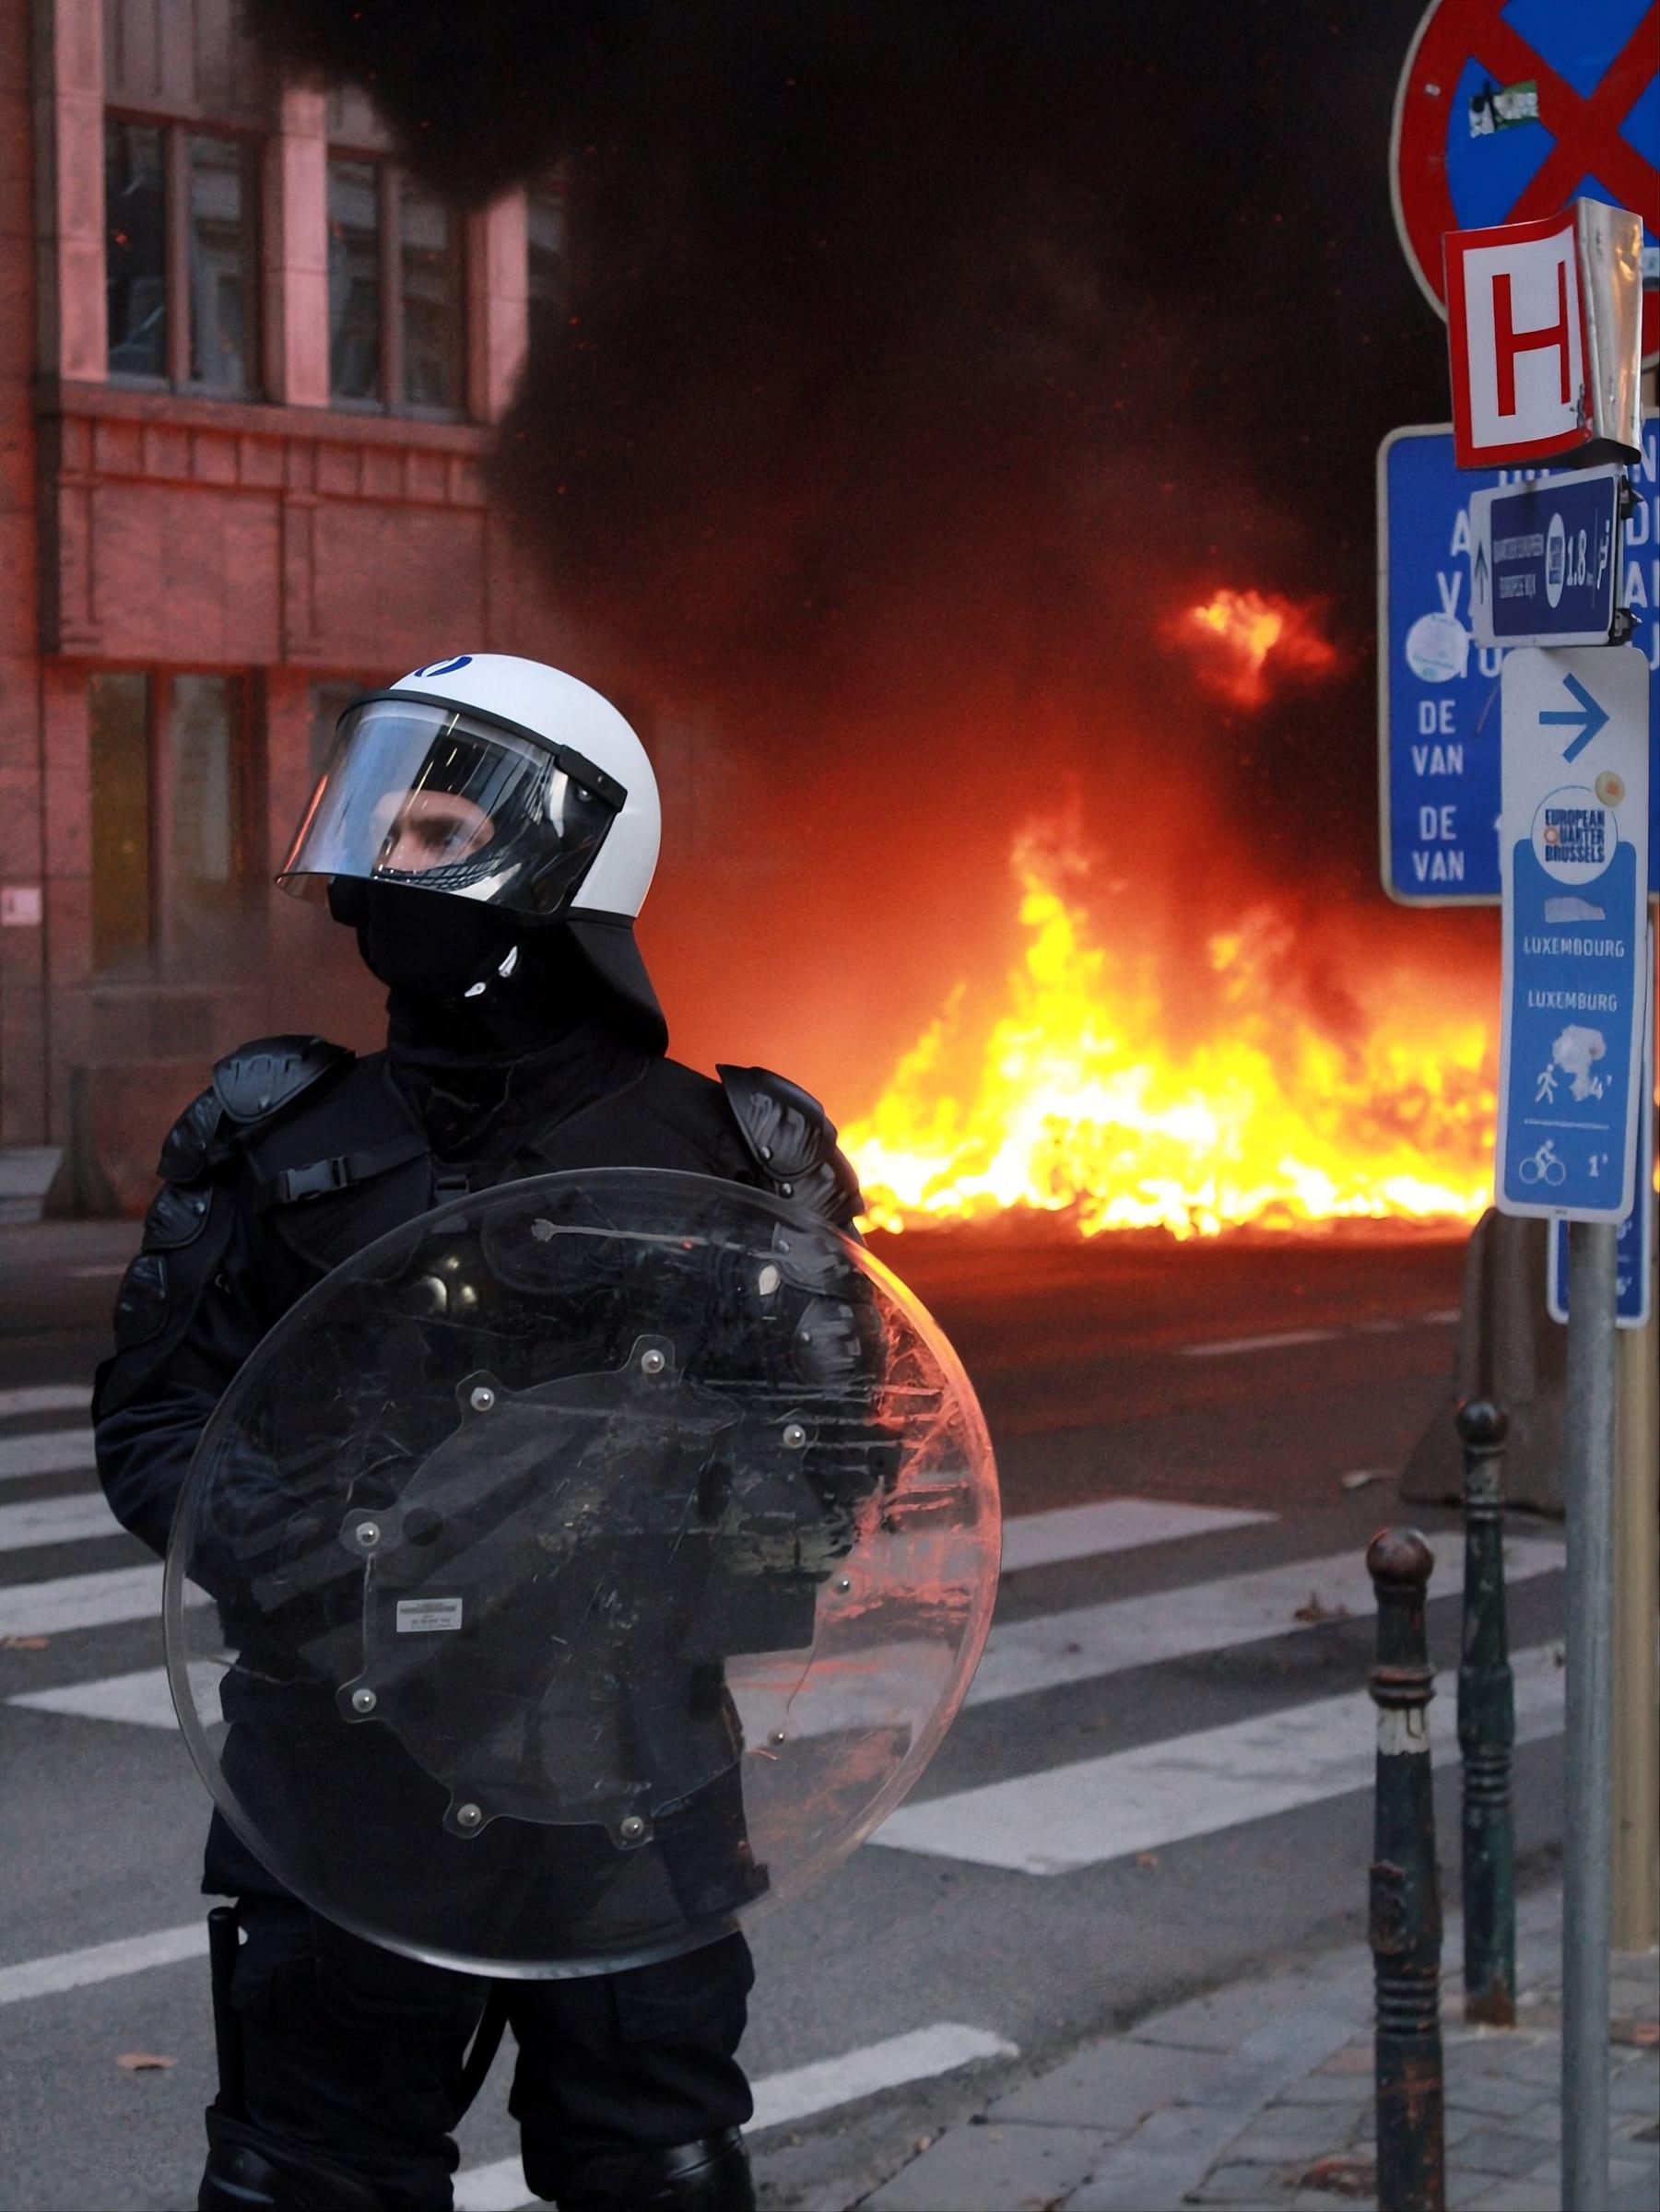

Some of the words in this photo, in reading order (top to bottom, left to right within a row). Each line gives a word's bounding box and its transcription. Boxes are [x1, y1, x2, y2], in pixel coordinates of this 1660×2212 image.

[1491, 259, 1572, 418] H
[1419, 699, 1456, 735] DE
[1411, 743, 1464, 777] VAN
[1419, 805, 1457, 841] DE
[1545, 807, 1606, 827] EUROPEAN
[1411, 850, 1466, 883] VAN
[1545, 844, 1606, 864] BRUSSELS
[1524, 935, 1625, 958] LUXEMBOURG
[1527, 988, 1619, 1013] LUXEMBURG
